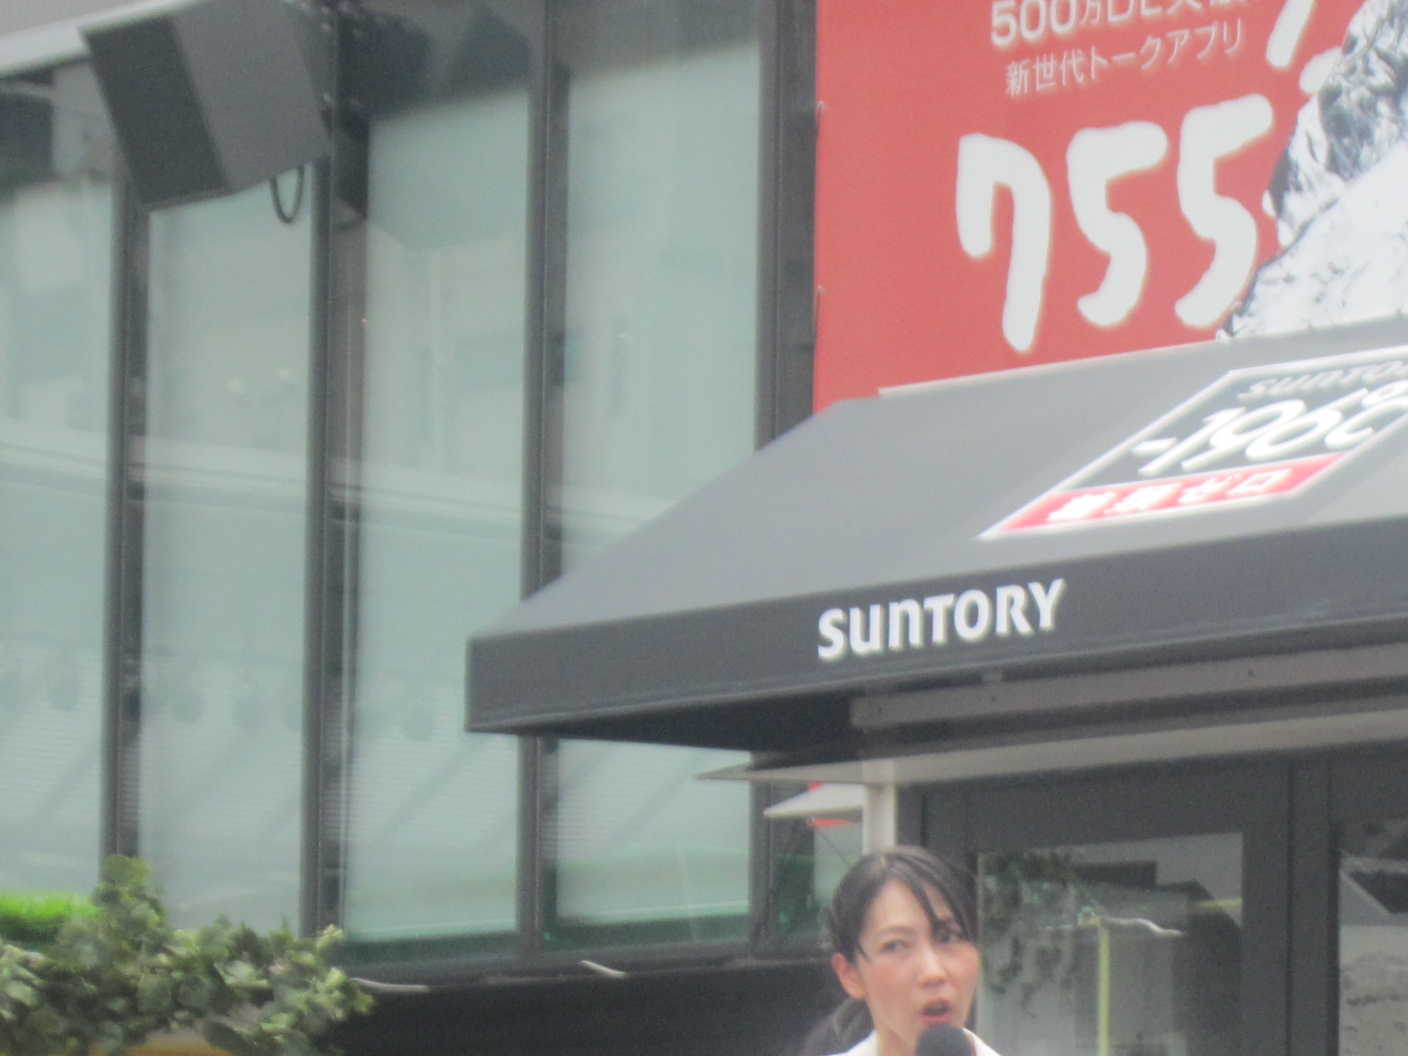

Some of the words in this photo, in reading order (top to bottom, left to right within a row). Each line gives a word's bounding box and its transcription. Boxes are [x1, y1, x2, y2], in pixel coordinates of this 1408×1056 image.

[1005, 18, 1243, 97] 新世代トークアプリ
[955, 94, 1274, 353] 755
